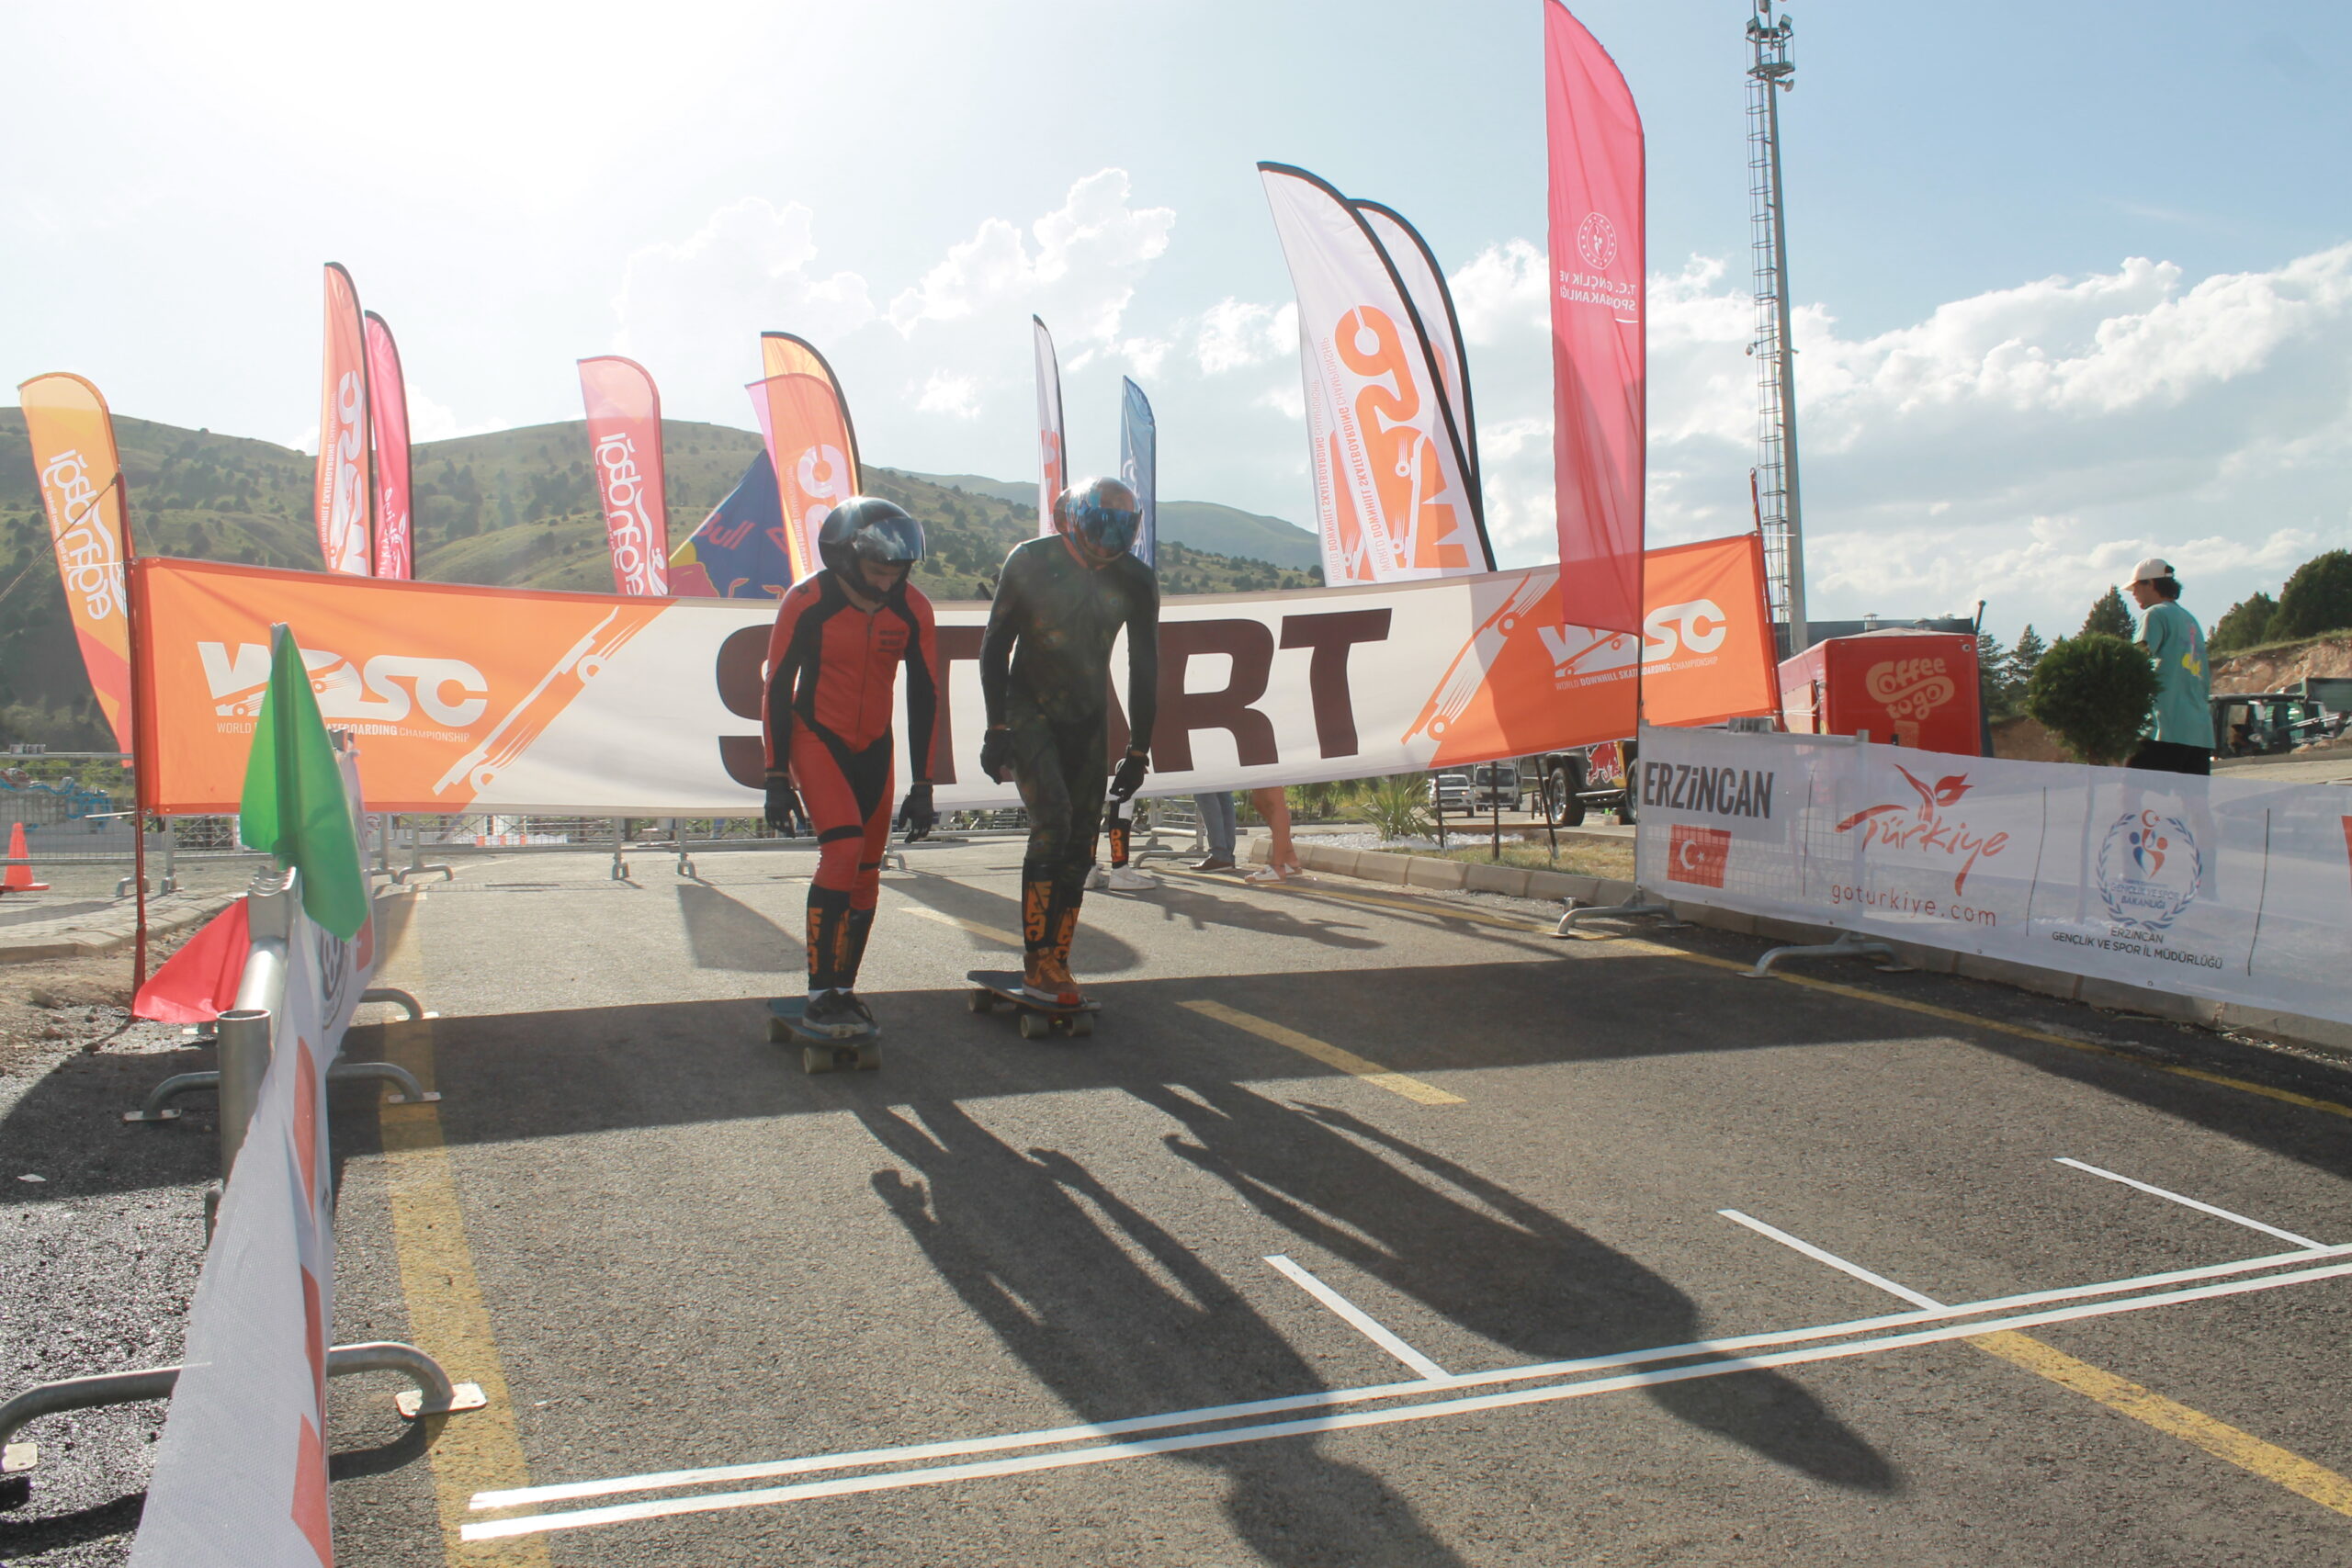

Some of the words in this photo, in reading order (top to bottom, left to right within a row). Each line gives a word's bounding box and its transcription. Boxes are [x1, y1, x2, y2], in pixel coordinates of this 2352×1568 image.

[1555, 676, 1579, 691] WORLD
[1579, 670, 1619, 687] DOWNHILL
[1671, 655, 1719, 671] CHAMPIONSHIP
[1866, 658, 1948, 704] Coffee
[1886, 699, 1913, 719] to
[1913, 684, 1941, 721] go
[217, 722, 252, 734] WORLD
[326, 723, 398, 736] ATEBOARDING
[399, 727, 470, 743] CHAMPIONSHIP
[1836, 802, 2009, 897] Türkiye
[1831, 884, 1996, 927] goturkiye.com
[2052, 931, 2095, 947] GENÇLİK
[2097, 939, 2110, 950] VE
[2112, 942, 2141, 955] SPOR
[2143, 944, 2152, 957] İL
[2154, 948, 2223, 970] MÜDÜRLÜĞÜ
